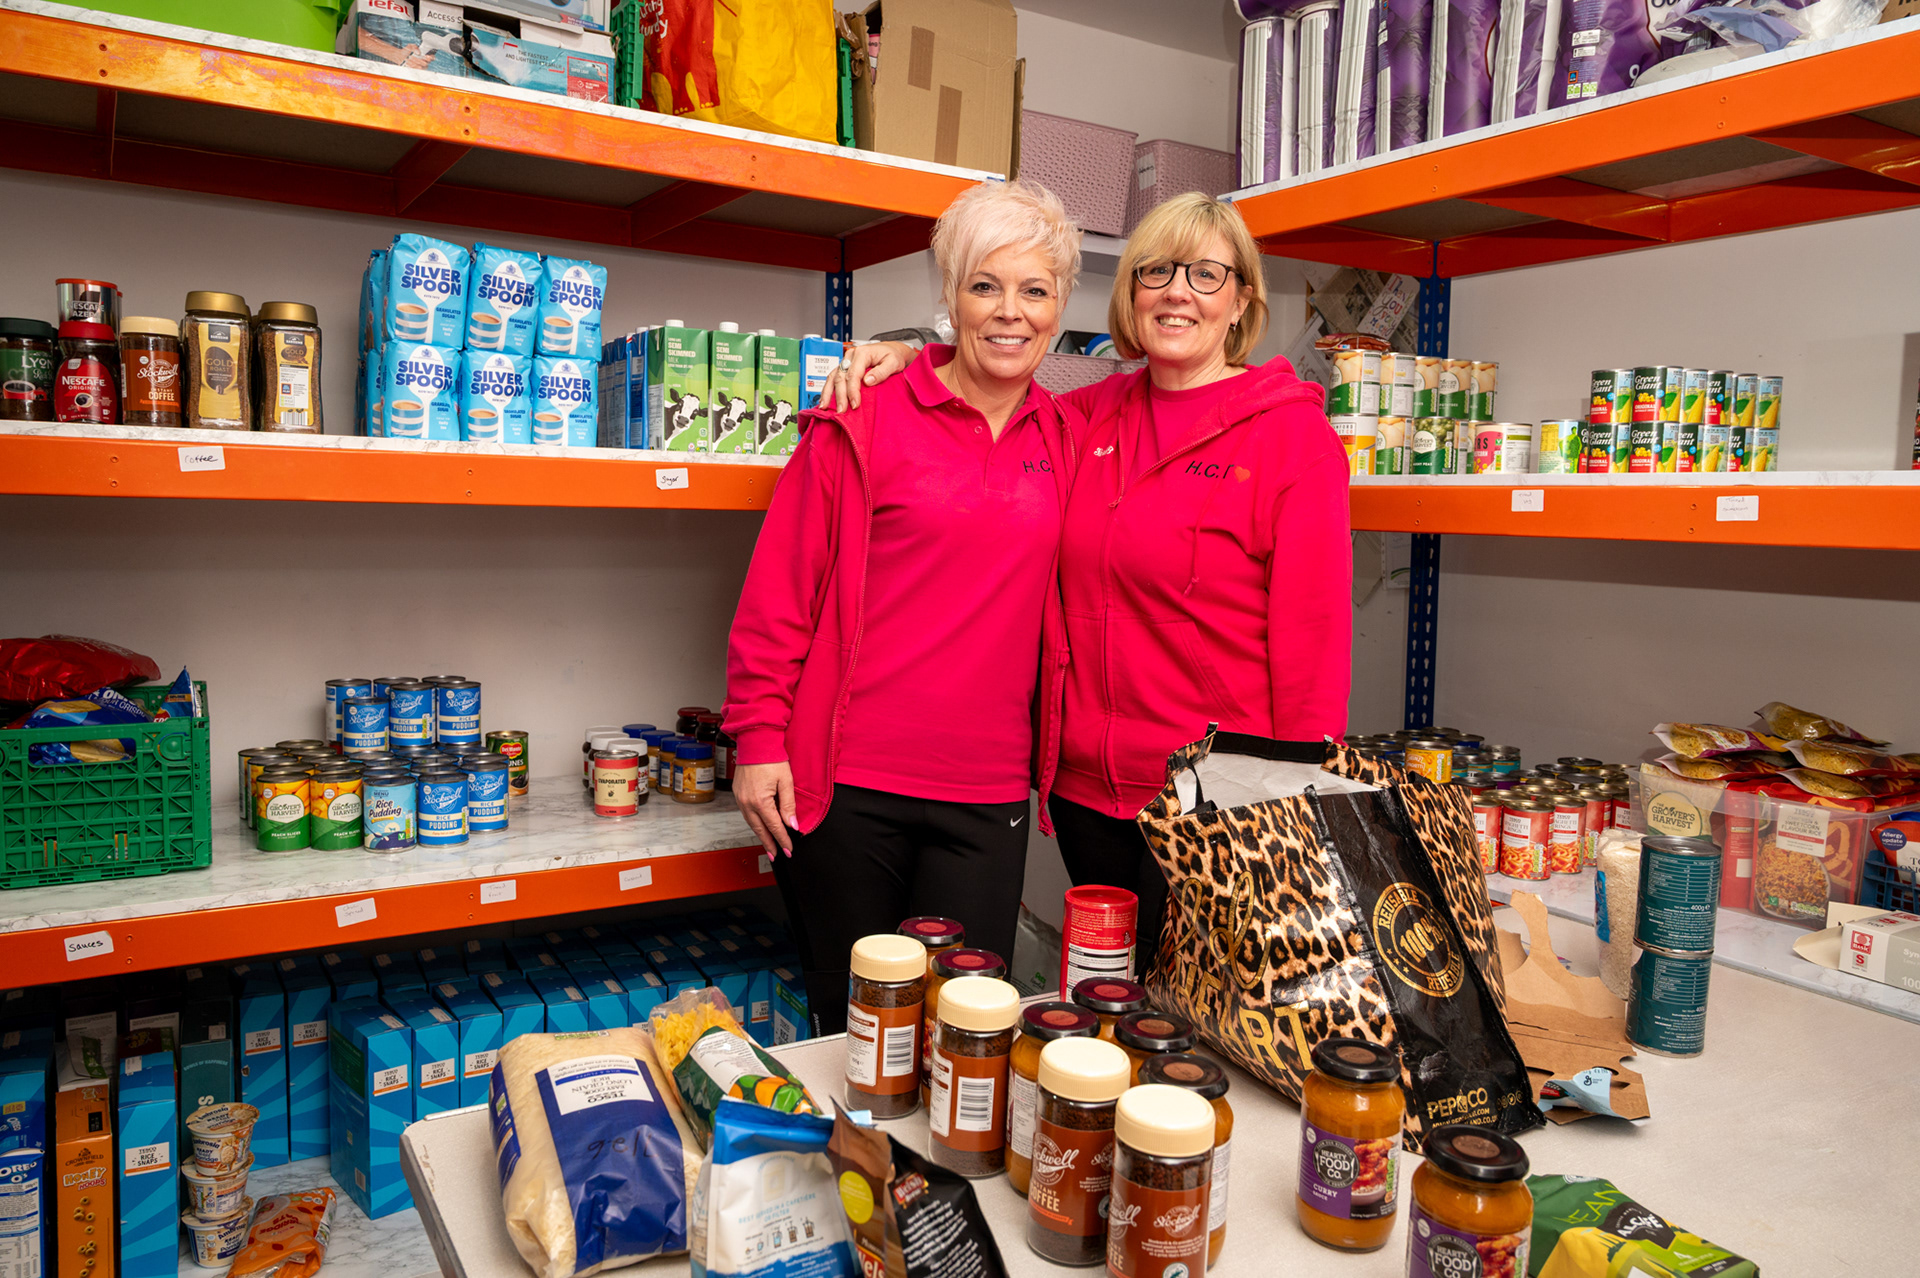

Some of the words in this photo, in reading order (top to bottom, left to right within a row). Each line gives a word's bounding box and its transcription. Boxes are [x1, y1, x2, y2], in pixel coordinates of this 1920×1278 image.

[427, 10, 454, 22] ACCESS
[516, 56, 538, 66] LIGHTEST
[404, 263, 461, 283] SILVER
[400, 275, 462, 296] SPOON
[481, 274, 535, 296] SILVER
[552, 279, 602, 299] SILVER
[478, 286, 534, 308] SPOON
[550, 291, 602, 311] SPOON
[668, 350, 696, 358] SKIMMED
[716, 354, 742, 362] SKIMMED
[206, 358, 234, 367] GOLD
[763, 357, 789, 366] SKIMMED
[137, 363, 179, 378] Stockwell
[398, 359, 453, 380] SILVER
[395, 373, 452, 391] SPOON
[472, 370, 524, 386] SILVER
[540, 375, 592, 391] SILVER
[148, 391, 174, 402] COFFEE
[470, 384, 524, 398] SPOON
[538, 388, 592, 403] SPOON
[184, 454, 218, 464] Coffee
[446, 692, 480, 708] Stockwell
[349, 708, 386, 723] Stockwell
[423, 786, 462, 804] Stockwell
[375, 800, 394, 809] Rice
[473, 807, 500, 815] PUDDING
[368, 806, 402, 818] Pudding
[1652, 806, 1696, 821] GROWER'S
[1652, 814, 1693, 829] HARVEST
[1785, 821, 1820, 831] SWEETCORN
[1781, 825, 1807, 836] FLAVOUR
[1882, 831, 1904, 839] Allergy
[1378, 888, 1420, 930] REUSABLE
[1400, 914, 1443, 963] 100%
[68, 940, 104, 952] Sauces
[1856, 954, 1865, 964] S
[1426, 951, 1460, 990] REUSABLE
[430, 1072, 446, 1080] SNAPS
[383, 1079, 399, 1087] SNAPS
[571, 1083, 601, 1093] GRAIN
[584, 1088, 606, 1096] COOK
[587, 1092, 627, 1103] TESCO
[65, 1154, 104, 1166] CROWNFIELD
[1321, 1150, 1346, 1160] HEARTY
[138, 1158, 158, 1166] SNAPS
[1320, 1156, 1350, 1171] FOOD
[0, 1161, 37, 1177] OREO
[1327, 1168, 1342, 1180] CO.
[64, 1167, 106, 1186] HONEY
[1312, 1191, 1328, 1201] SAUCE
[1313, 1184, 1338, 1198] CURRY
[1437, 1245, 1468, 1258] HEARTY
[1434, 1252, 1472, 1271] FOOD
